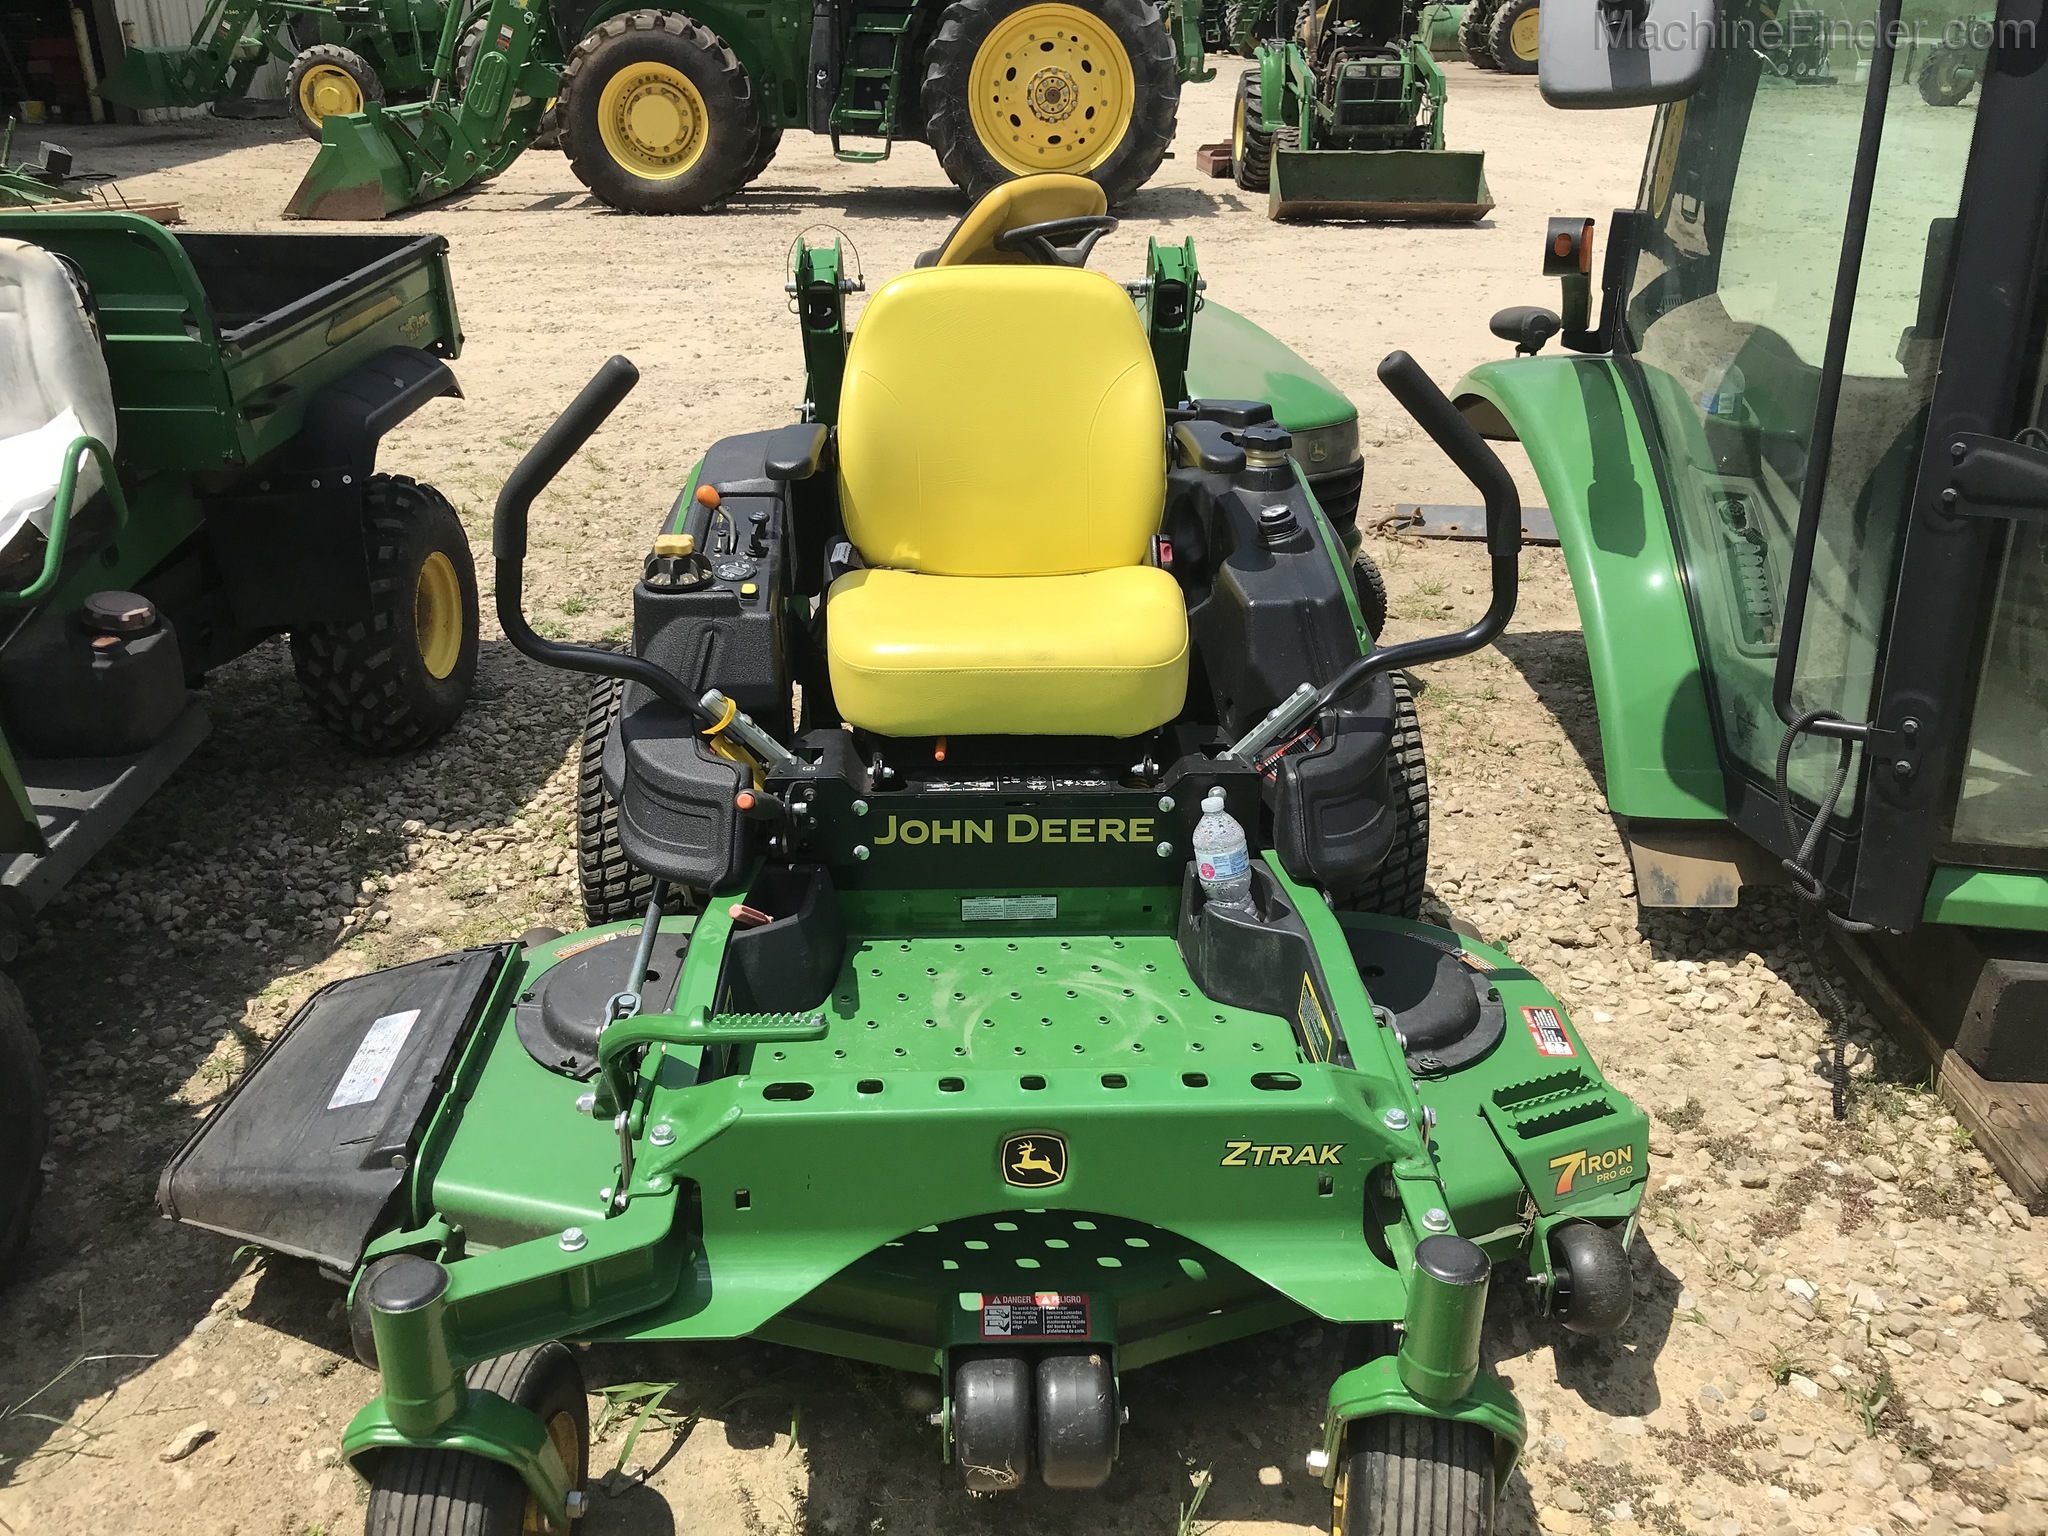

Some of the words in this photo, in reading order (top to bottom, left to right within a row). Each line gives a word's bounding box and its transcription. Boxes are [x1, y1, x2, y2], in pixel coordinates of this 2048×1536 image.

[874, 815, 993, 844] JOHN
[1007, 814, 1155, 843] DEERE
[1220, 1141, 1344, 1166] ZTRAK
[1596, 1170, 1617, 1184] PRO
[1619, 1165, 1633, 1177] 60
[1003, 1296, 1032, 1304] DANGER
